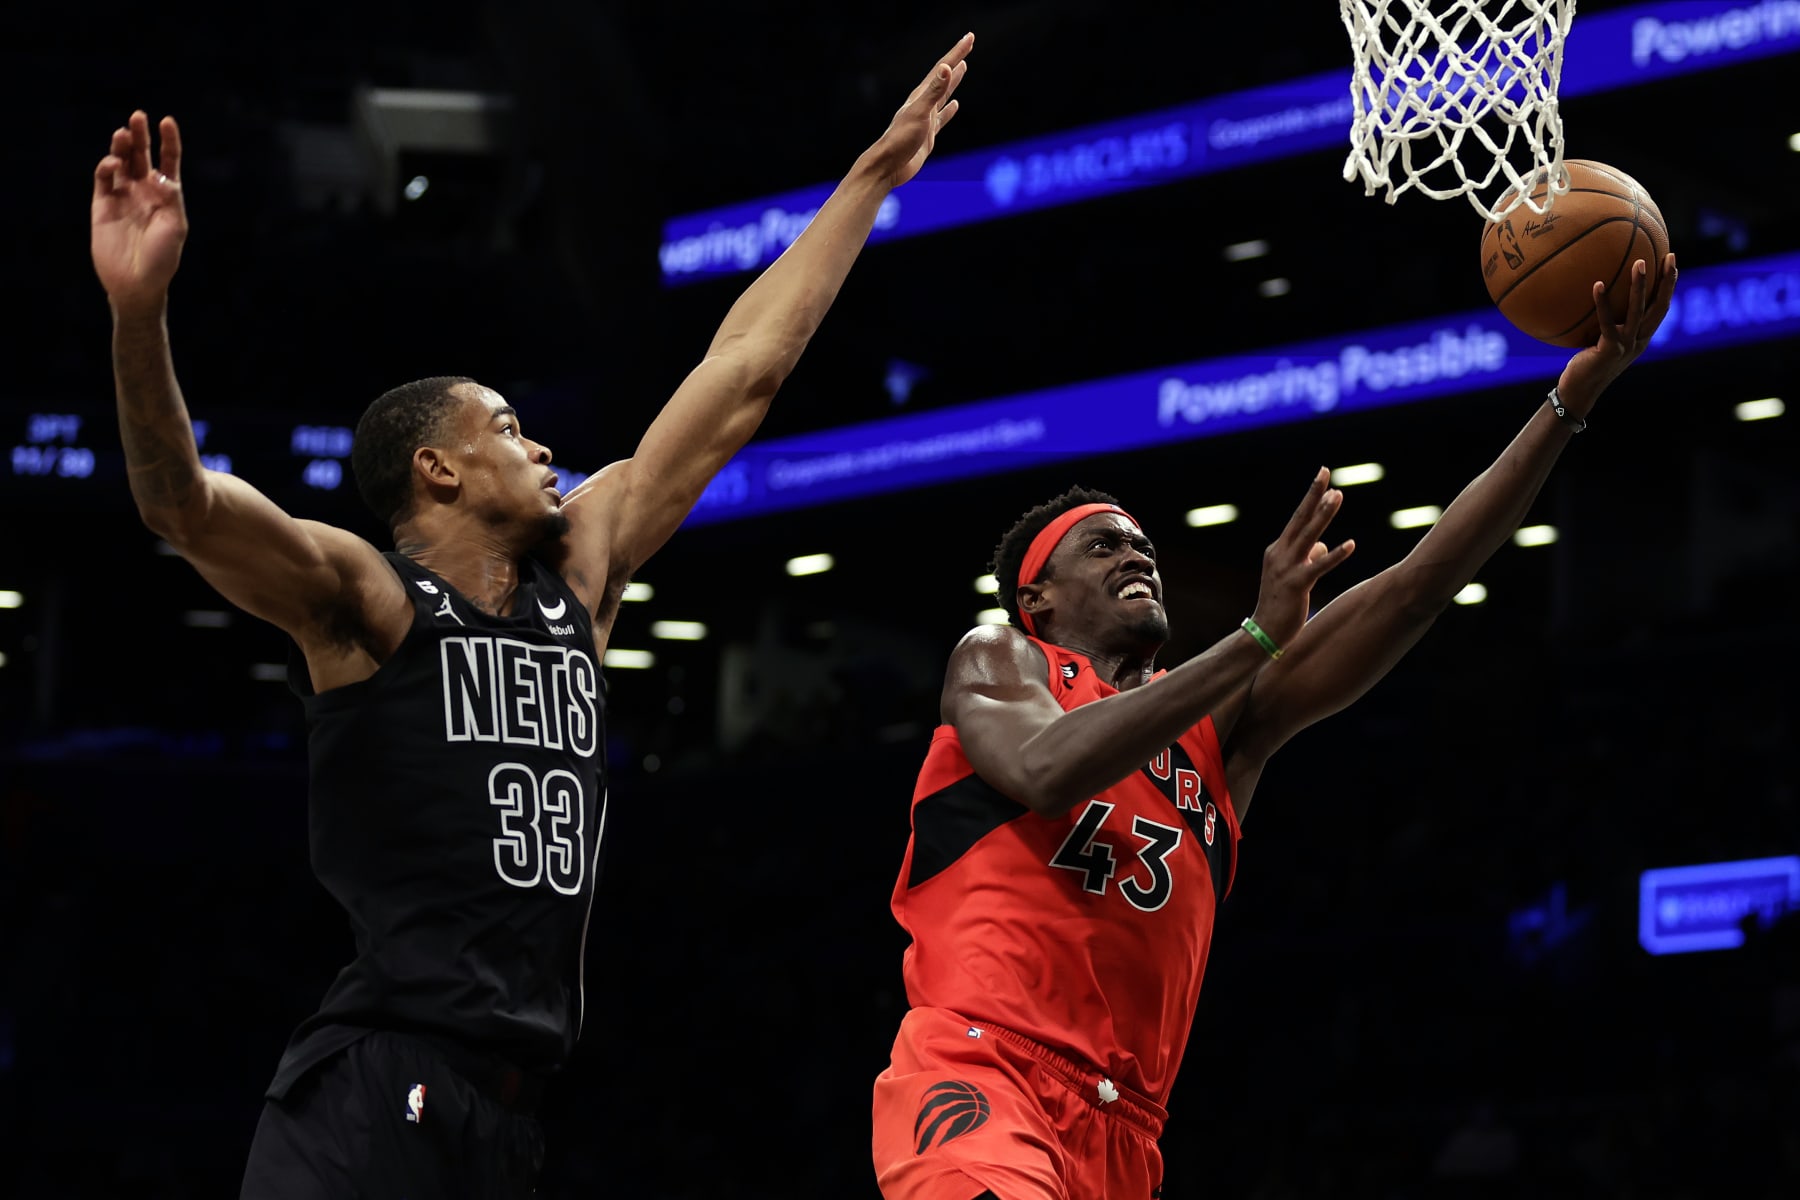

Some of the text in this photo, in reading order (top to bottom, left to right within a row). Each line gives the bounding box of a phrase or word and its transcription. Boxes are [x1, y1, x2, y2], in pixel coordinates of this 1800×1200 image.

[1157, 358, 1340, 428] Powering
[1339, 323, 1508, 396] Possible
[440, 637, 598, 758] NETS
[487, 762, 584, 895] 33
[1048, 799, 1183, 912] 43
